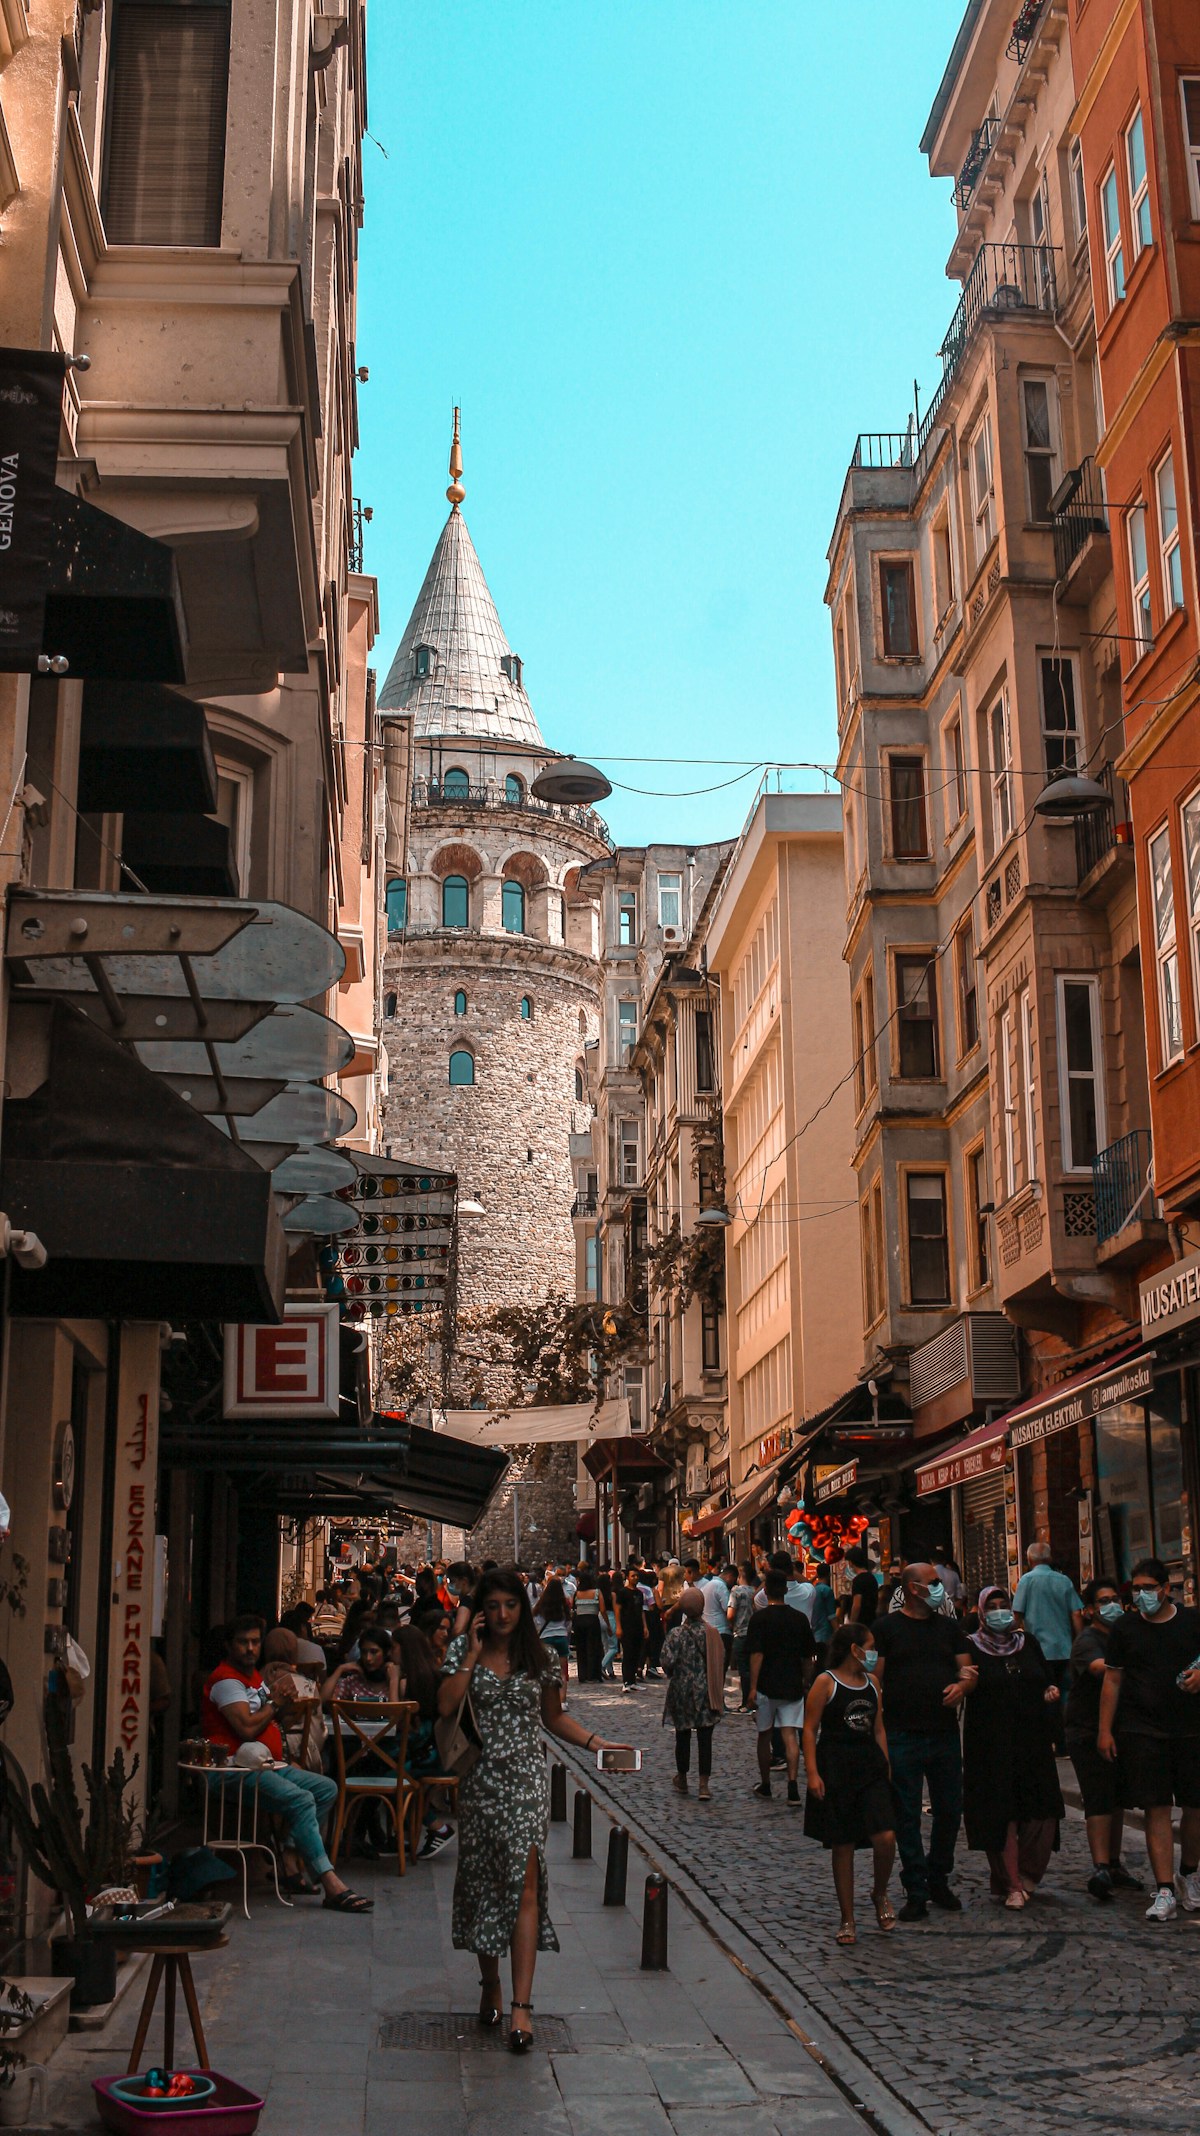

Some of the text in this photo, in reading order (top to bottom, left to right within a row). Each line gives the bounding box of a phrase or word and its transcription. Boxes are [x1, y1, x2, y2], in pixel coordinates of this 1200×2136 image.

[0, 452, 20, 551] GENOVA
[255, 1328, 307, 1391] E
[1011, 1418, 1045, 1446] MUSATEK
[1045, 1397, 1084, 1431] ELEKTRİK
[121, 1485, 145, 1751] ECZANE PHARMACY
